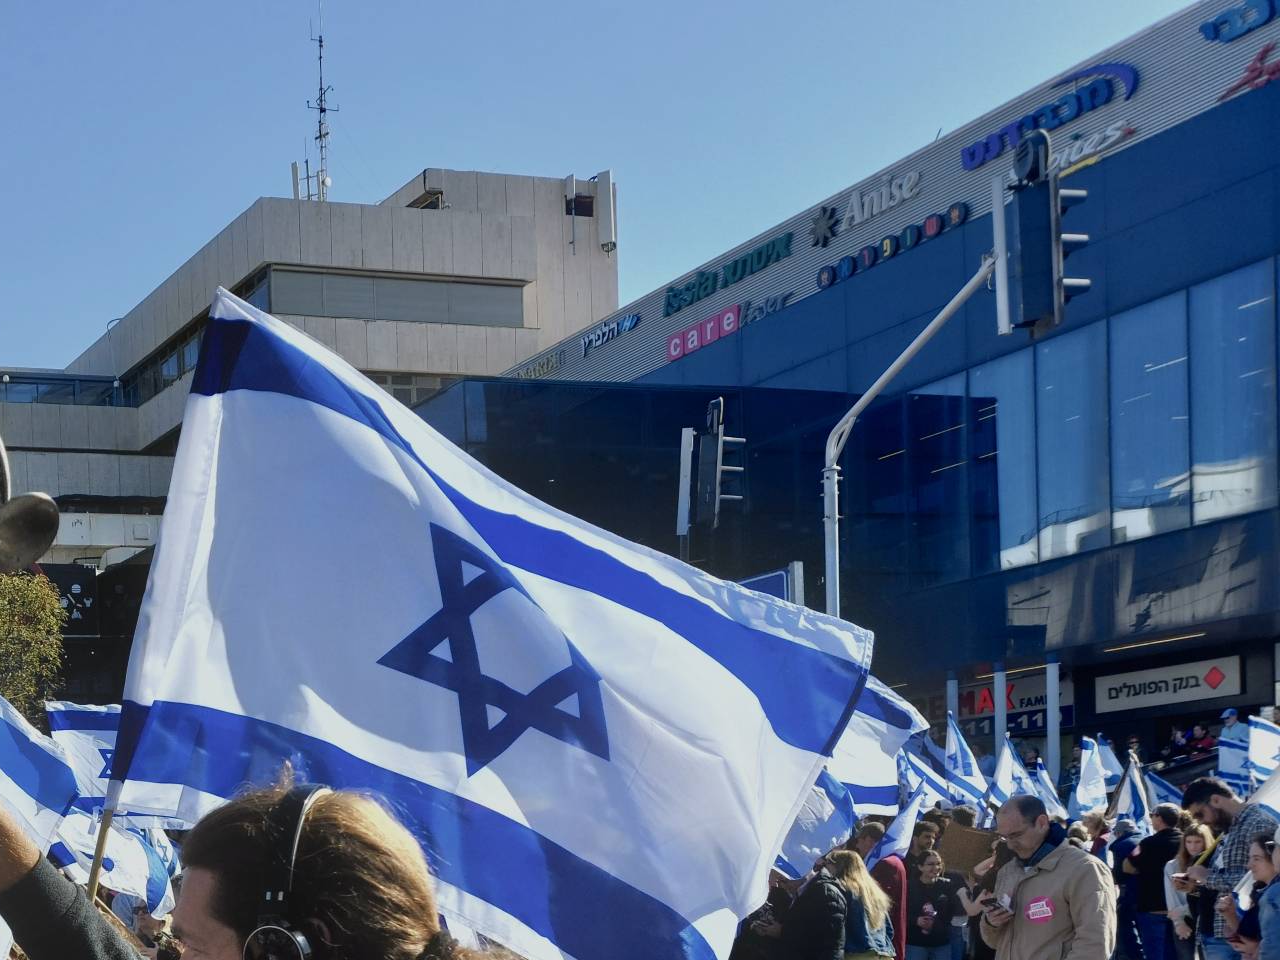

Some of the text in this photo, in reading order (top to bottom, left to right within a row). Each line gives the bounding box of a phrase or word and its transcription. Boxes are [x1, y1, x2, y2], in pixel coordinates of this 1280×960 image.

[1199, 0, 1280, 43] כבי
[839, 171, 920, 231] Anise
[670, 311, 735, 356] care
[1020, 693, 1062, 708] FAMI
[1108, 675, 1200, 700] בנק הפועלים
